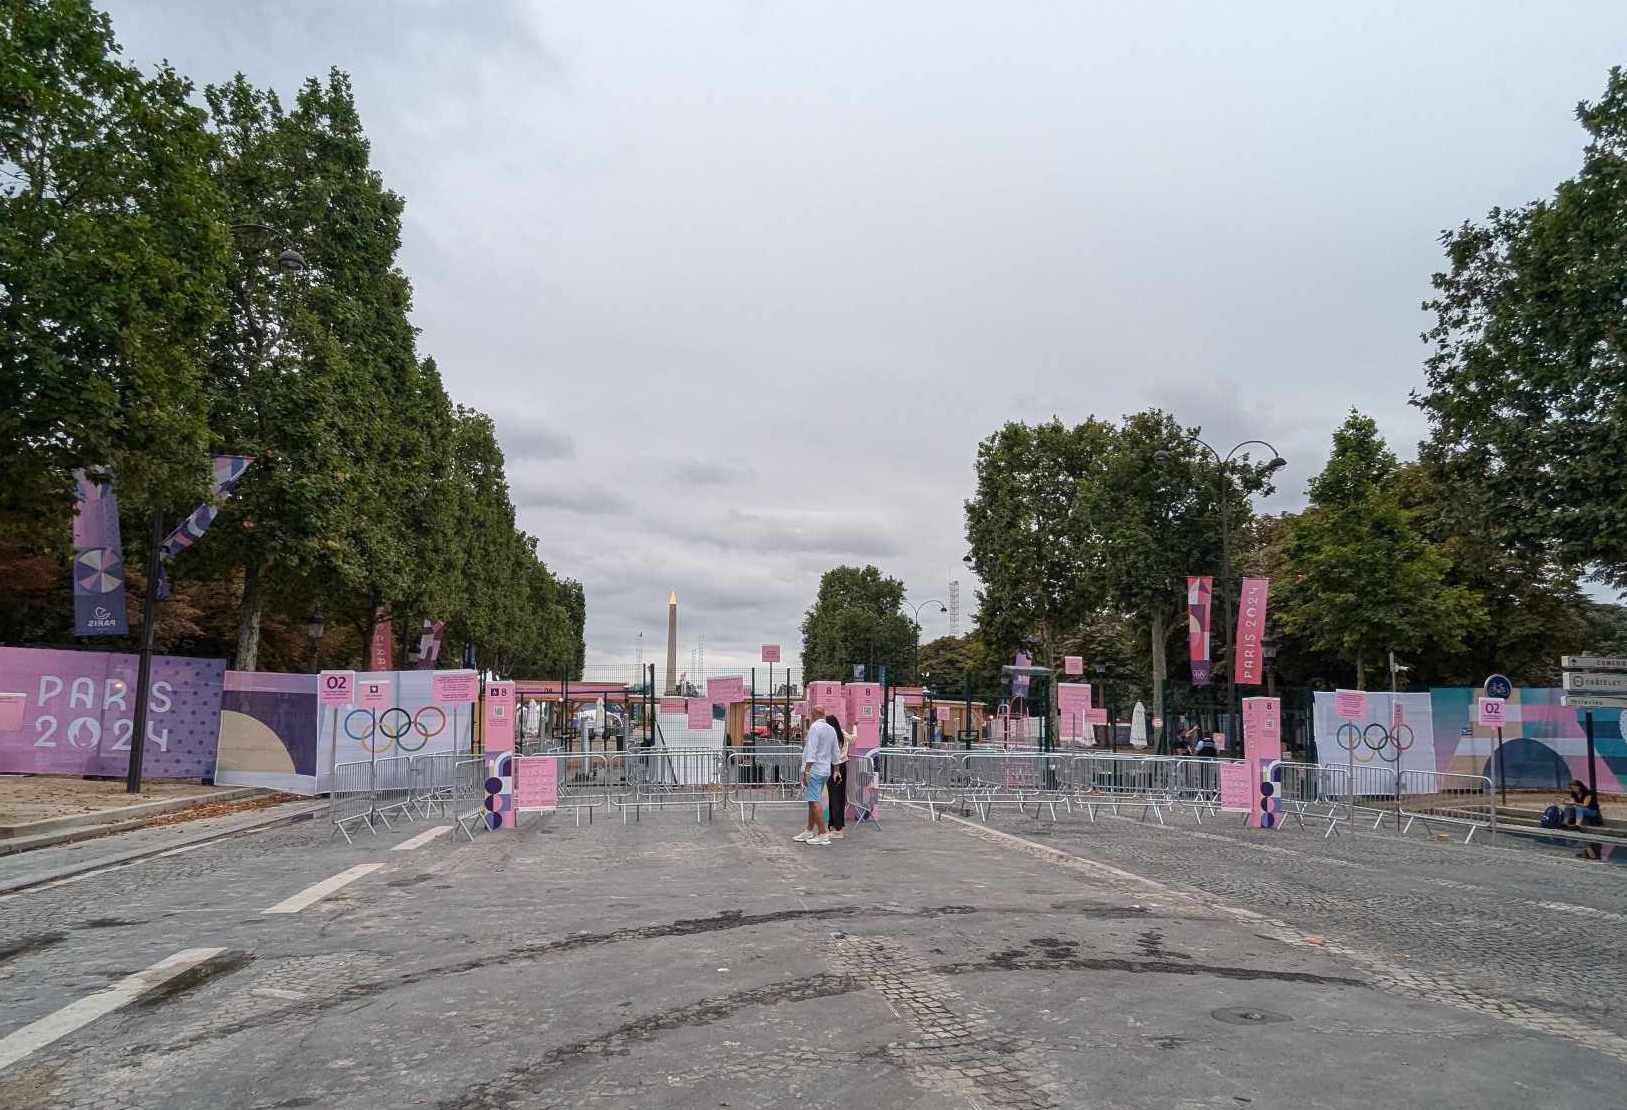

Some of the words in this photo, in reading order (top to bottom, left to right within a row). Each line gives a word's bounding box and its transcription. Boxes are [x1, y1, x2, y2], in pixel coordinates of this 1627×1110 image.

[1245, 587, 1260, 627] 2024
[1244, 635, 1256, 679] PARIS
[37, 675, 173, 713] PARS
[326, 676, 346, 690] 02
[1485, 703, 1501, 714] 02
[33, 715, 169, 752] 2024
